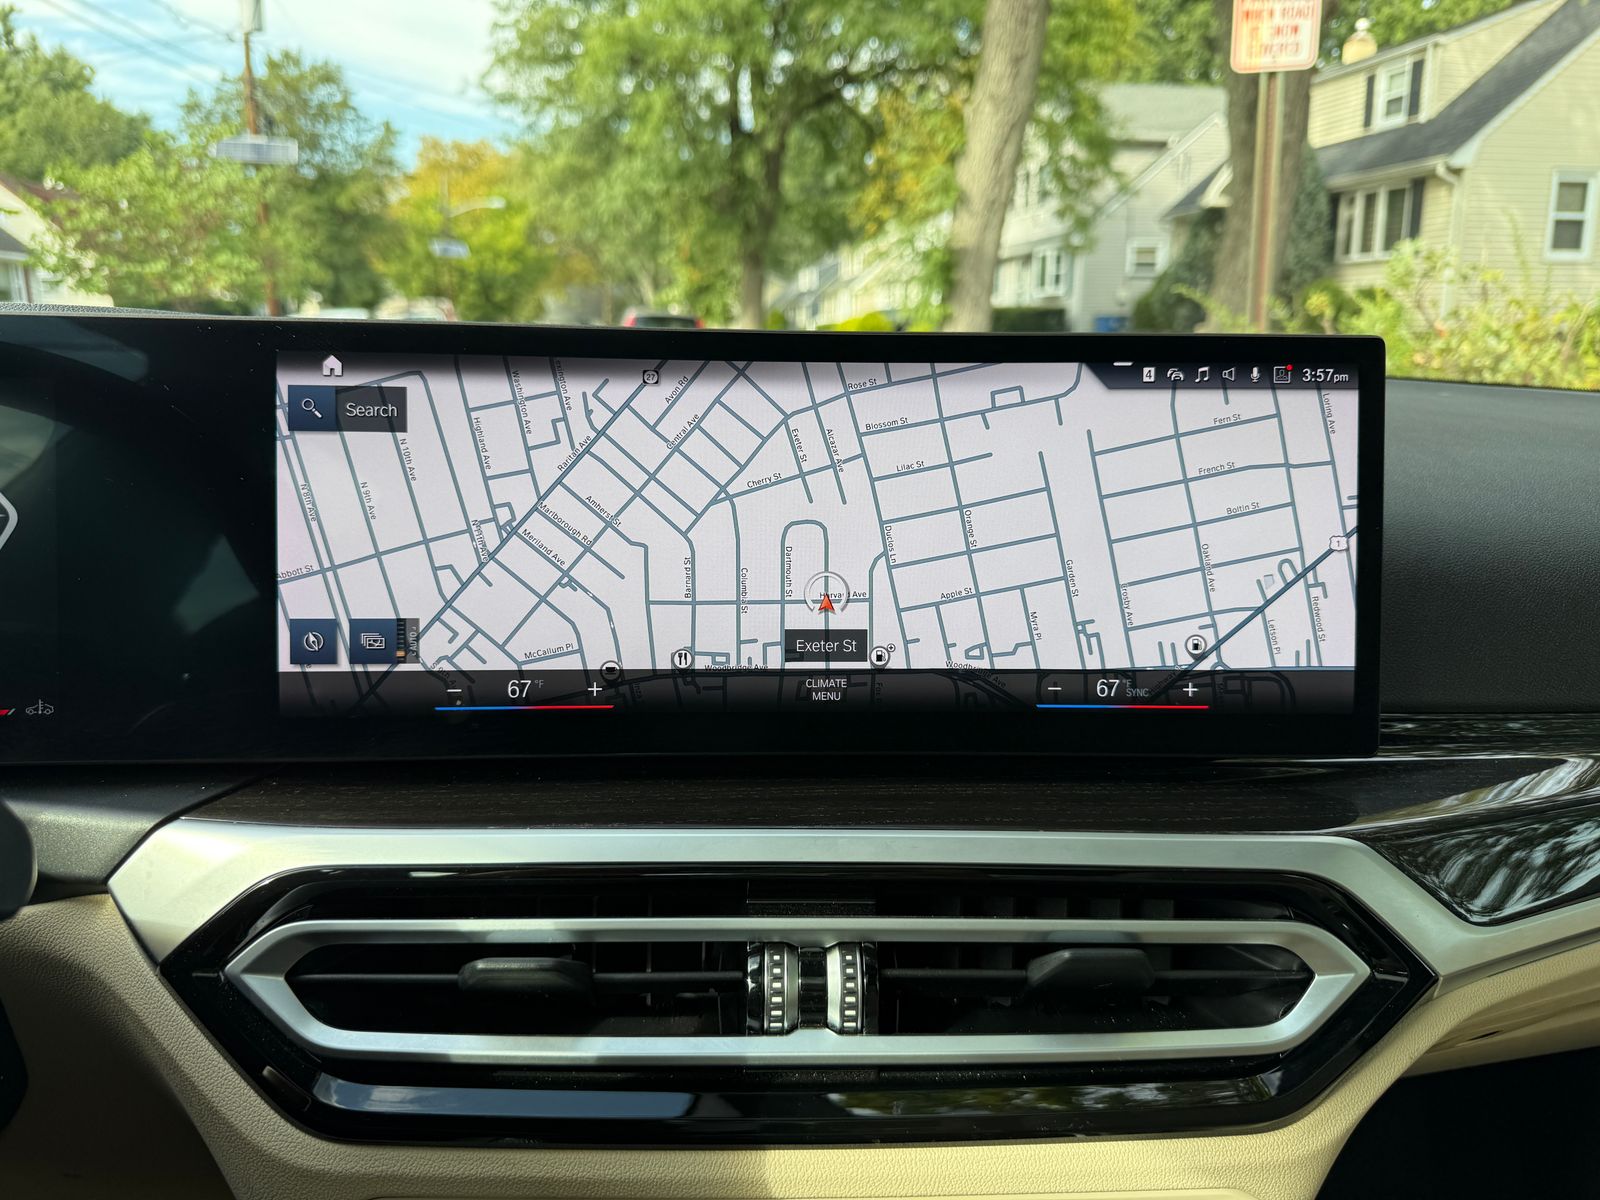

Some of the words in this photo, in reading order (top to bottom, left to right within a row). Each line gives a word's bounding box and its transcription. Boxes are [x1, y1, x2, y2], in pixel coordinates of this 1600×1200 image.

[646, 373, 656, 381] 27
[1145, 369, 1152, 380] 4
[1302, 368, 1348, 383] 3:57pm
[664, 386, 680, 404] Avon
[678, 376, 688, 387] Rd
[848, 380, 867, 390] Rose
[868, 378, 877, 386] St
[346, 402, 398, 417] Search
[512, 370, 528, 418] Washington
[524, 418, 532, 435] Ave
[564, 395, 572, 410] Ave
[1213, 416, 1231, 425] Fern
[1323, 393, 1331, 418] Loring
[1328, 418, 1336, 434] Ave
[666, 427, 689, 450] Central
[686, 414, 700, 429] Ave
[866, 419, 899, 431] Blossom
[474, 416, 489, 454] Highland
[482, 454, 491, 470] Ave
[792, 428, 804, 453] Exeter
[800, 454, 807, 463] St
[826, 428, 839, 456] Alcazar
[836, 457, 844, 473] Ave
[557, 448, 581, 472] Raritan
[578, 435, 592, 452] Ave
[403, 447, 412, 465] 10th
[408, 466, 417, 481] Ave
[896, 463, 915, 472] Lilac
[916, 460, 924, 468] St
[1198, 463, 1225, 474] French
[747, 476, 772, 489] Cherry
[773, 472, 782, 480] St
[363, 490, 372, 504] 9th
[303, 492, 312, 507] 8th
[308, 508, 316, 522] Ave
[367, 506, 376, 520] Ave
[586, 496, 613, 521] Amherst
[612, 517, 621, 527] St
[1226, 504, 1250, 515] Boltin
[539, 502, 581, 537] Marlborough
[581, 535, 592, 546] Rd
[965, 510, 974, 538] Orange
[970, 539, 977, 548] St
[885, 525, 894, 553] Duclos
[890, 554, 897, 564] Ln
[480, 547, 489, 562] Ave
[552, 553, 566, 567] Ave
[684, 557, 691, 565] St
[1201, 544, 1212, 576] Oakland
[1066, 560, 1076, 588] Garden
[1072, 588, 1079, 597] St
[786, 589, 792, 598] St
[940, 589, 963, 599] Apple
[964, 587, 973, 595] St
[741, 606, 748, 614] St
[1030, 611, 1039, 631] Myra
[1035, 632, 1042, 640] Pl
[1126, 612, 1134, 626] Ave
[1312, 596, 1324, 633] Redwood
[1318, 634, 1325, 642] St
[1268, 620, 1278, 646] Letson
[1274, 647, 1281, 655] Pl
[524, 645, 565, 659] McCallum
[796, 640, 839, 652] Exeter
[843, 639, 857, 652] St
[754, 664, 768, 672] Ave
[507, 680, 531, 698] 67
[806, 679, 847, 688] CLIMATE
[1097, 680, 1119, 697] 67
[812, 692, 841, 700] MENU
[1126, 688, 1149, 697] SYNC
